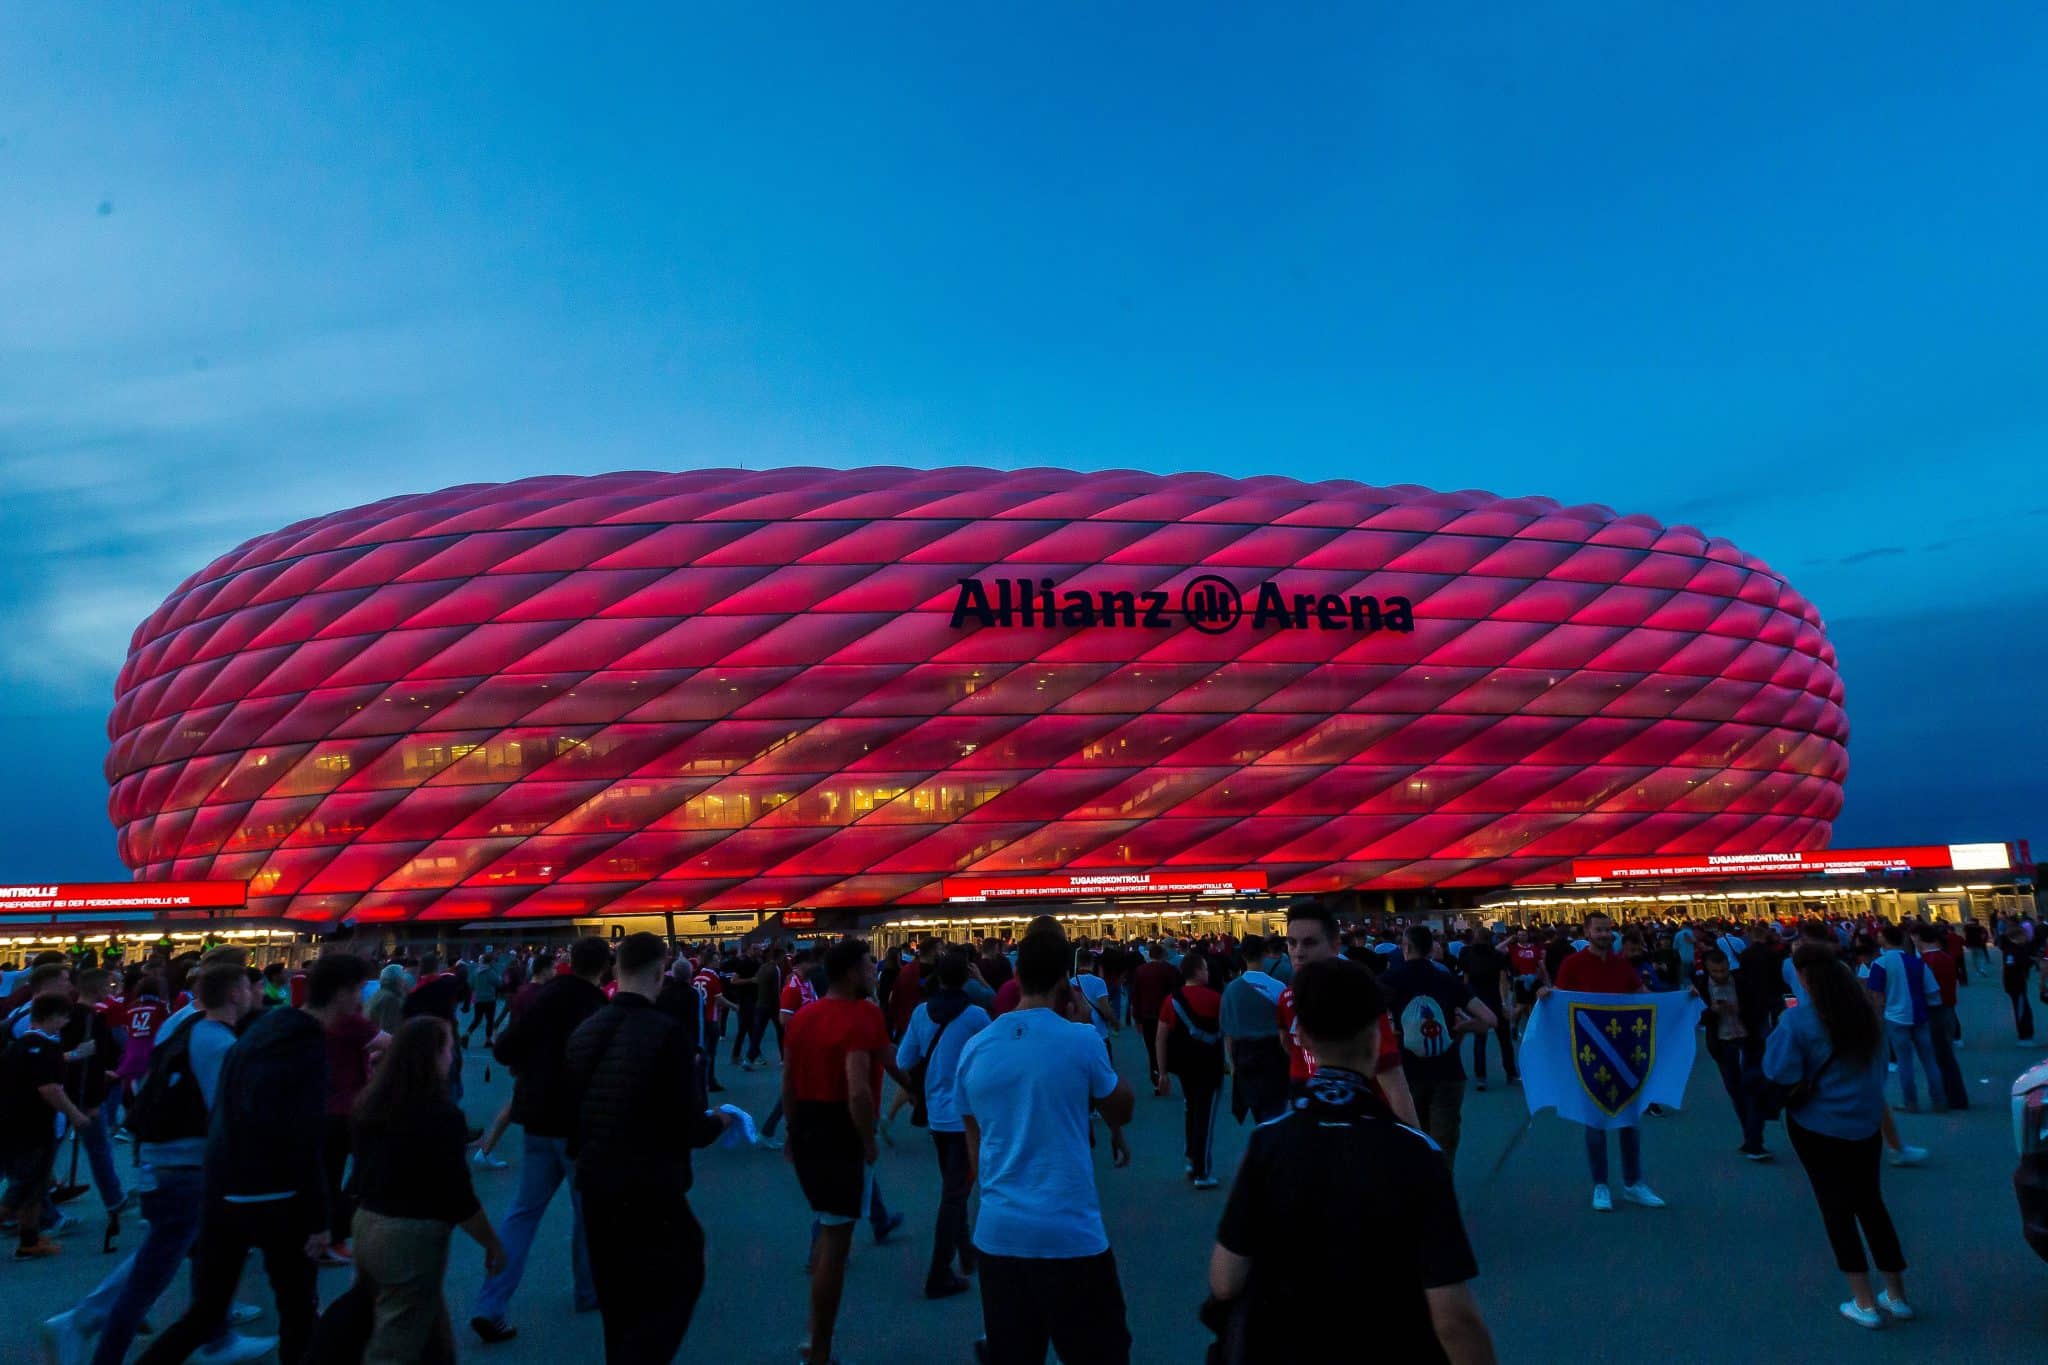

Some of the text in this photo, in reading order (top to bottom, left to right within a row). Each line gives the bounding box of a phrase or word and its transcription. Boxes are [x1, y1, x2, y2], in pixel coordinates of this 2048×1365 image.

[949, 577, 1415, 633] Allianz Arena
[1708, 853, 1802, 864] ZUGANGSKONTROLLE
[1070, 875, 1150, 886] ZUGANGSKONTROLLE
[68, 899, 84, 907] DER
[86, 898, 172, 907] PERSONENKONTROLLE
